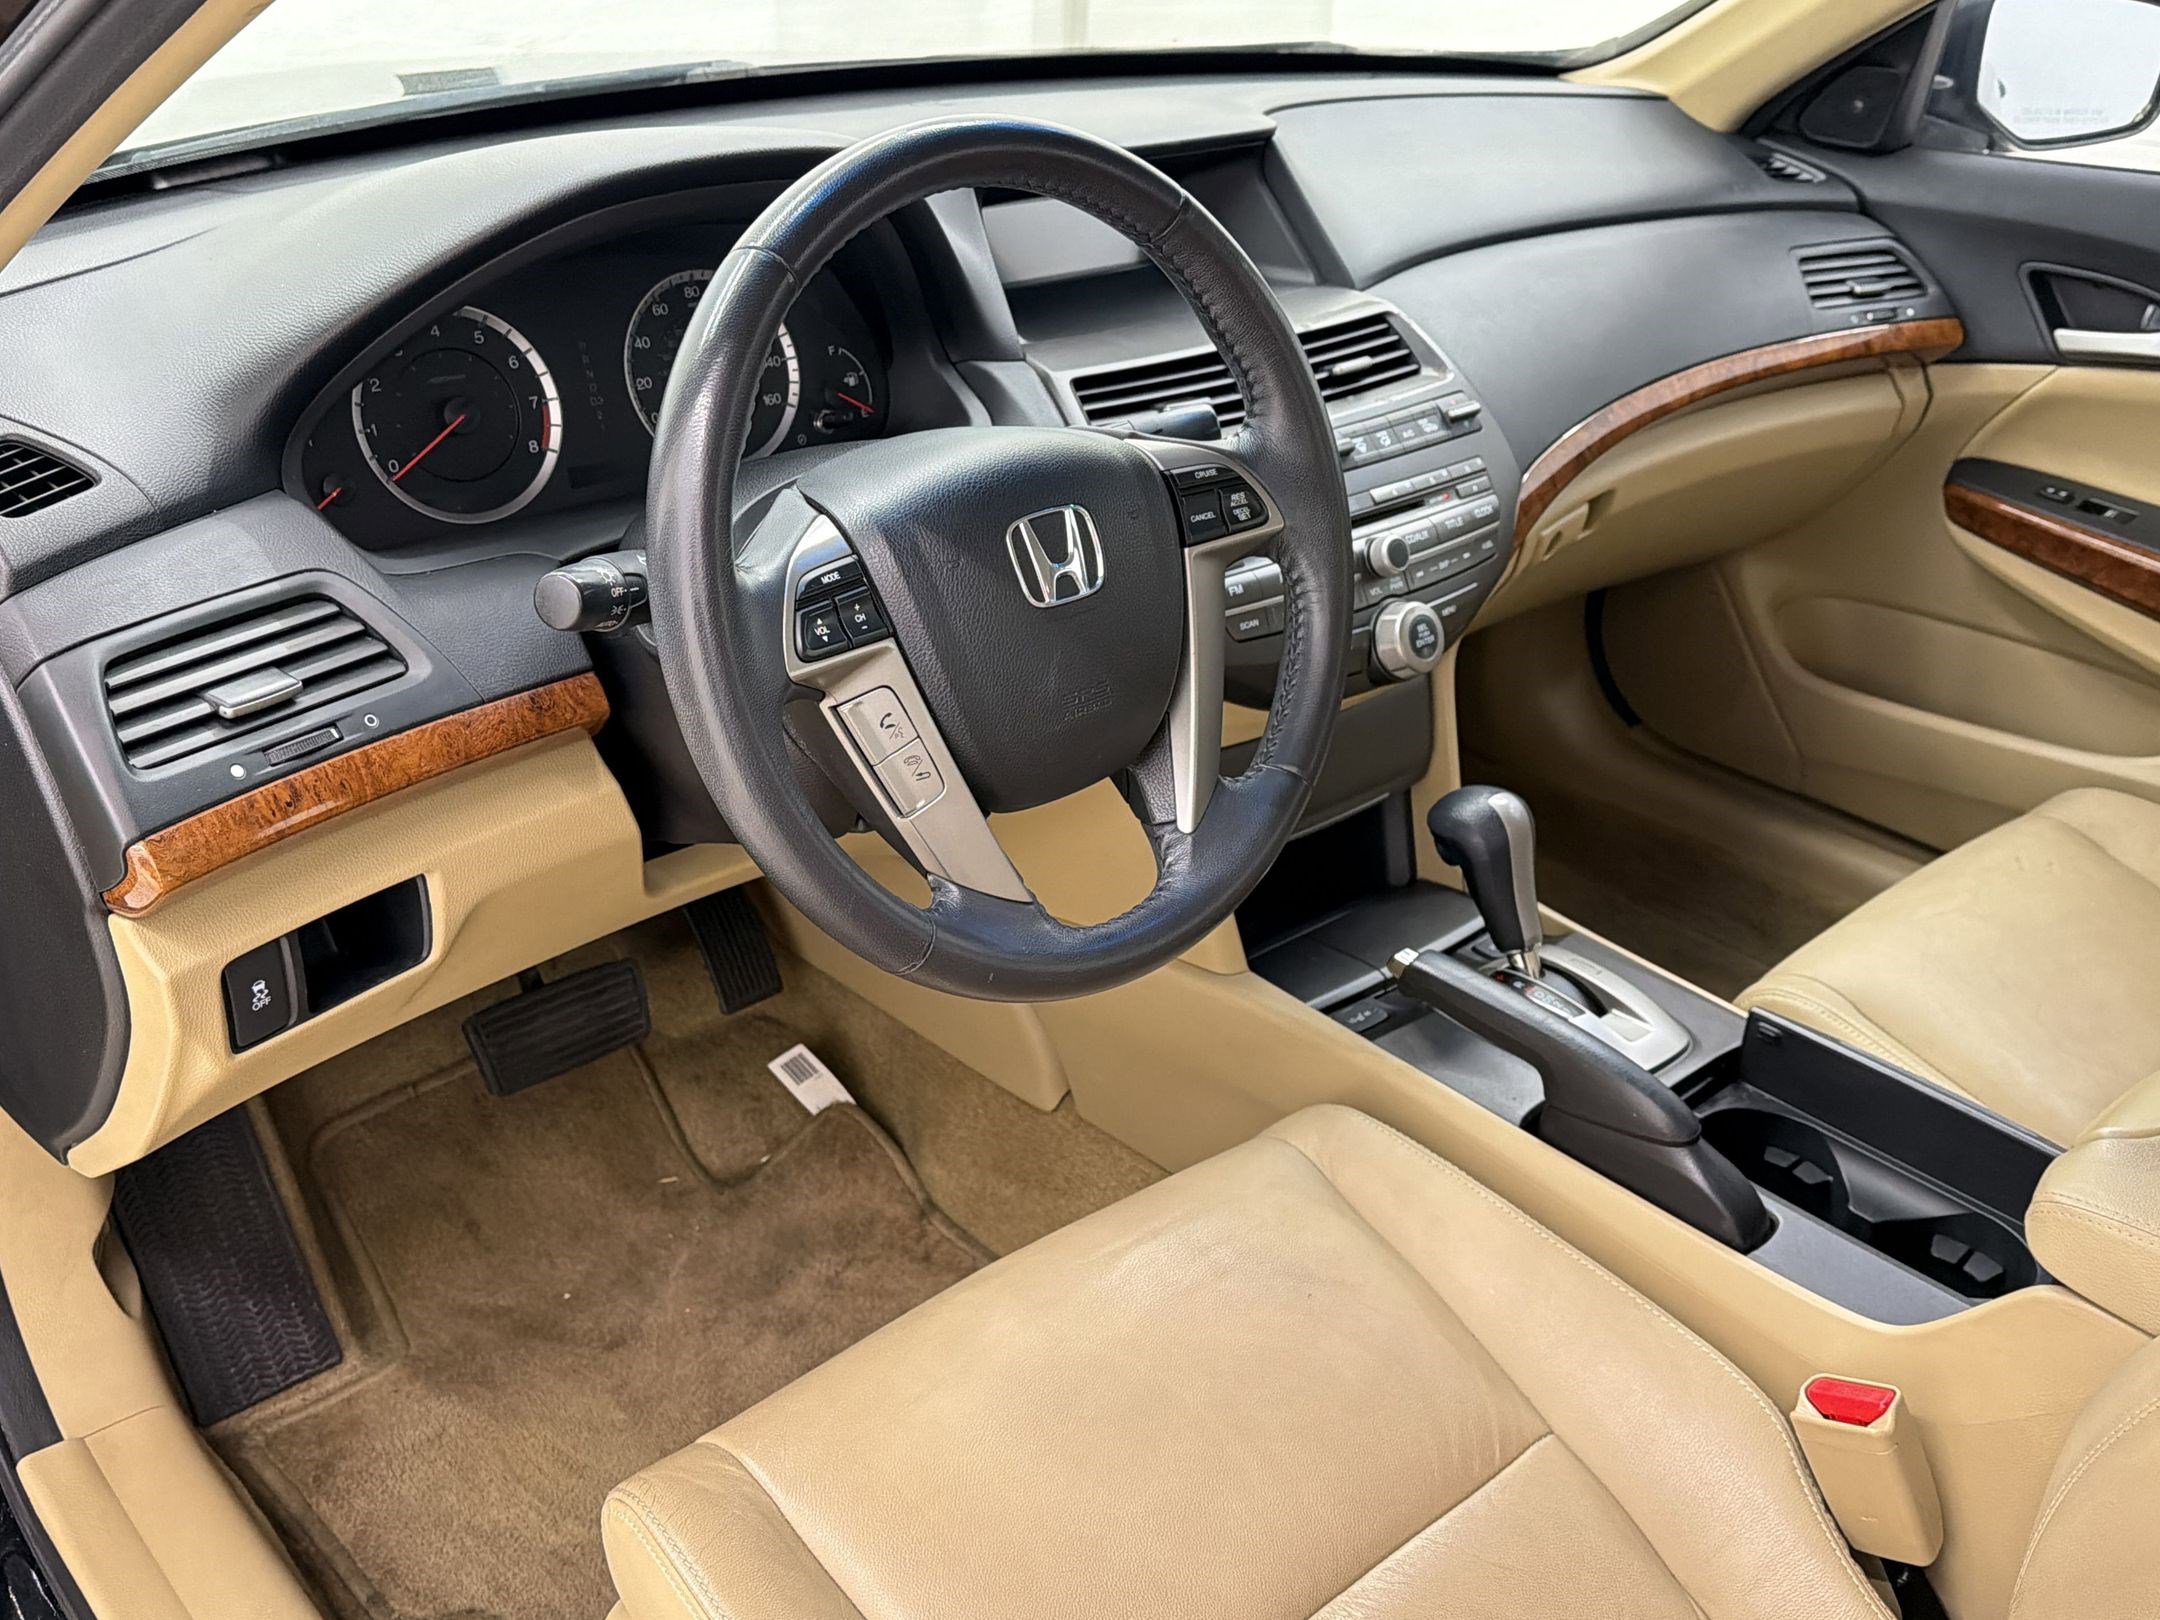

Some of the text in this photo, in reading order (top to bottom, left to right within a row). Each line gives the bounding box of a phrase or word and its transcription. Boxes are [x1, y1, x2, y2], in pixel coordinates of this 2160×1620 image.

[683, 286, 700, 299] 80
[652, 303, 669, 316] 60
[430, 325, 440, 337] 4
[474, 330, 485, 344] 5
[634, 338, 651, 350] 40
[828, 345, 835, 356] F
[508, 355, 519, 369] 6
[763, 356, 782, 368] 40
[369, 379, 382, 393] 2
[636, 378, 653, 391] 20
[528, 396, 538, 409] 7
[762, 393, 782, 406] 160
[370, 424, 378, 437] 1
[528, 440, 539, 453] 8
[387, 460, 399, 473] 0
[1194, 468, 1218, 479] CRUISE
[1231, 492, 1245, 501] RES
[1190, 511, 1216, 523] CANCEL
[821, 571, 840, 584] MODE
[611, 587, 624, 597] OFF
[854, 613, 866, 622] CH
[1239, 618, 1259, 630] SCAN
[814, 625, 830, 636] VOL
[252, 997, 272, 1011] OFF
